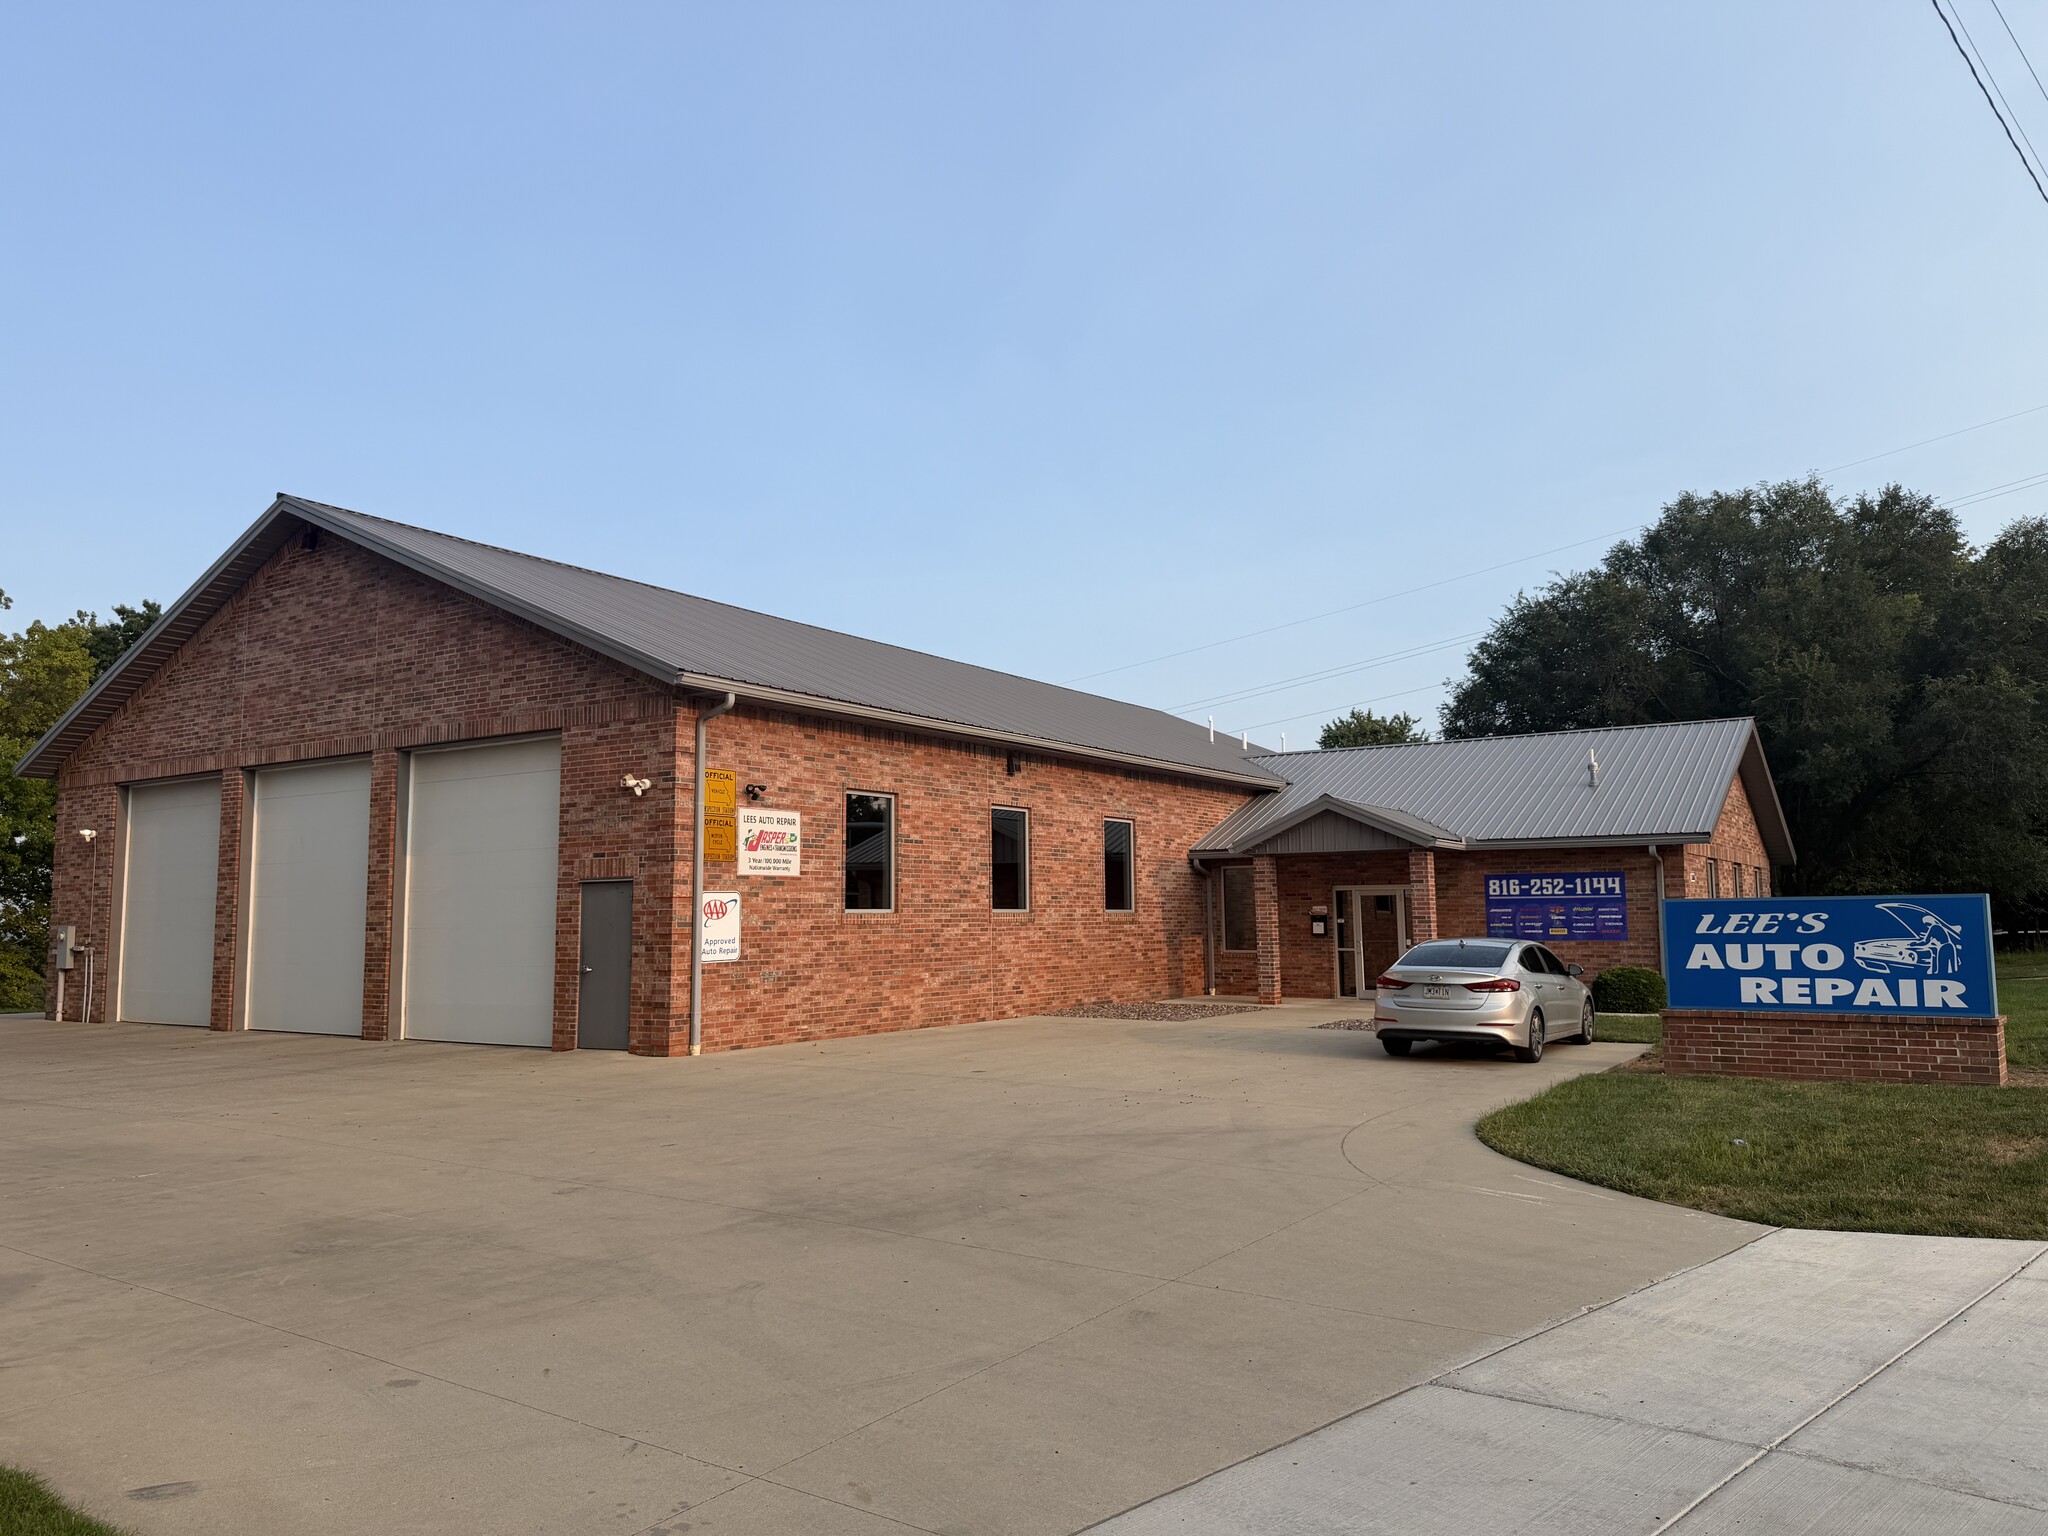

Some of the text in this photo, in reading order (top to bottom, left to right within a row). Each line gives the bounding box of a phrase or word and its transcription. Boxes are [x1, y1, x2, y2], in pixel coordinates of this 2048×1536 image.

[705, 771, 734, 781] OFFICIAL
[704, 818, 734, 828] OFFICIAL
[743, 815, 797, 826] LEES AUTO REPAIR
[1489, 877, 1621, 896] 816-252-1144
[704, 899, 727, 920] AAA
[1695, 912, 1829, 935] LEE'S
[704, 937, 736, 946] Approved
[719, 946, 738, 955] Repair
[1685, 943, 1845, 971] AUTO
[1740, 976, 1969, 1008] REPAIR
